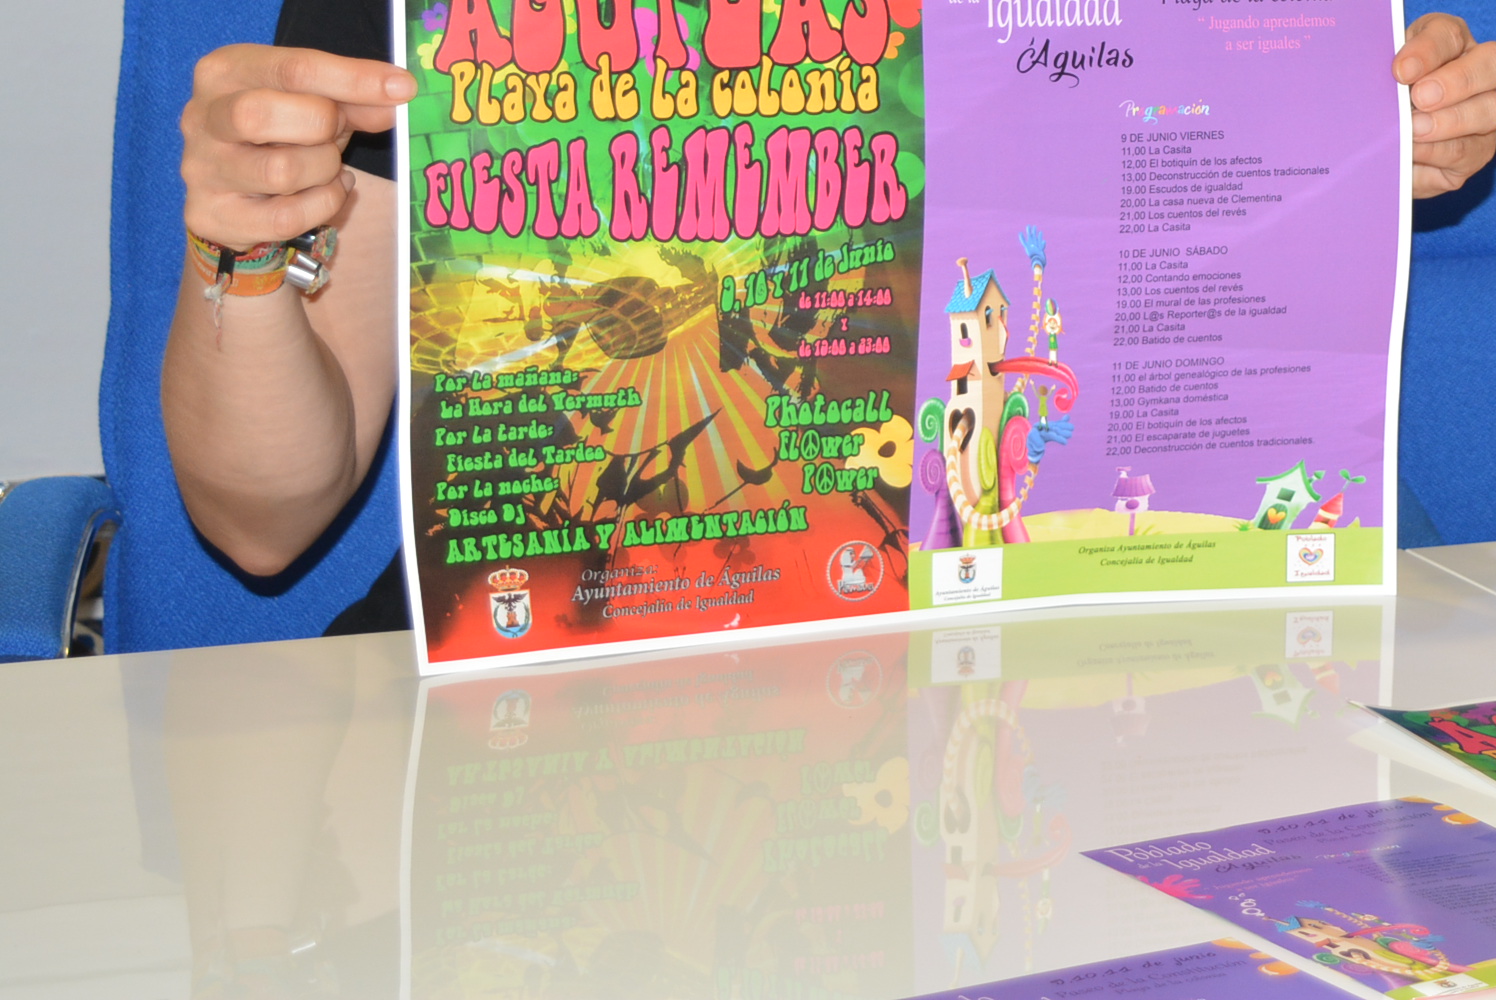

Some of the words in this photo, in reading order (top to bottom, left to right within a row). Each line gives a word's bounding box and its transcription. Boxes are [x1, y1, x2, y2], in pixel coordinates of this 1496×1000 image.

[1209, 15, 1260, 32] Jugando
[1263, 14, 1336, 31] aprendemos
[1225, 41, 1232, 51] a
[1236, 40, 1254, 51] ser
[1258, 36, 1301, 54] iguales
[589, 53, 641, 122] de
[1118, 99, 1210, 125] Programación
[1129, 132, 1144, 143] DE
[1146, 131, 1178, 143] JUNIO
[1179, 130, 1225, 142] VIERNES
[1148, 145, 1161, 156] La
[1162, 144, 1192, 155] Casita
[1149, 158, 1159, 168] El
[1160, 157, 1198, 169] botiquín
[1199, 156, 1212, 167] de
[1213, 156, 1228, 167] los
[1229, 155, 1263, 166] afectos
[423, 137, 600, 240] FIESTA
[608, 121, 908, 243] REMEMBER
[1148, 169, 1220, 181] Deconstrucción
[1221, 168, 1234, 179] de
[1235, 167, 1272, 179] cuentos
[1273, 165, 1330, 177] tradicionales
[1148, 183, 1189, 194] Escudos
[1190, 183, 1203, 193] de
[1204, 181, 1243, 194] igualdad
[1148, 197, 1160, 207] La
[1162, 198, 1185, 207] casa
[1186, 197, 1215, 206] nueva
[1216, 194, 1229, 205] de
[1230, 192, 1282, 205] Clementina
[814, 250, 835, 282] de
[435, 373, 467, 393] Por
[765, 390, 893, 427] Photocall
[435, 427, 467, 446] Por
[436, 481, 468, 500] Por
[446, 519, 591, 564] ARTESANÍA
[595, 523, 615, 549] Y
[571, 577, 690, 605] Ayuntamiento
[695, 571, 715, 588] de
[717, 559, 780, 587] Águilas
[602, 599, 672, 618] Concejalía
[676, 597, 692, 610] de
[696, 591, 755, 611] Igualdad
